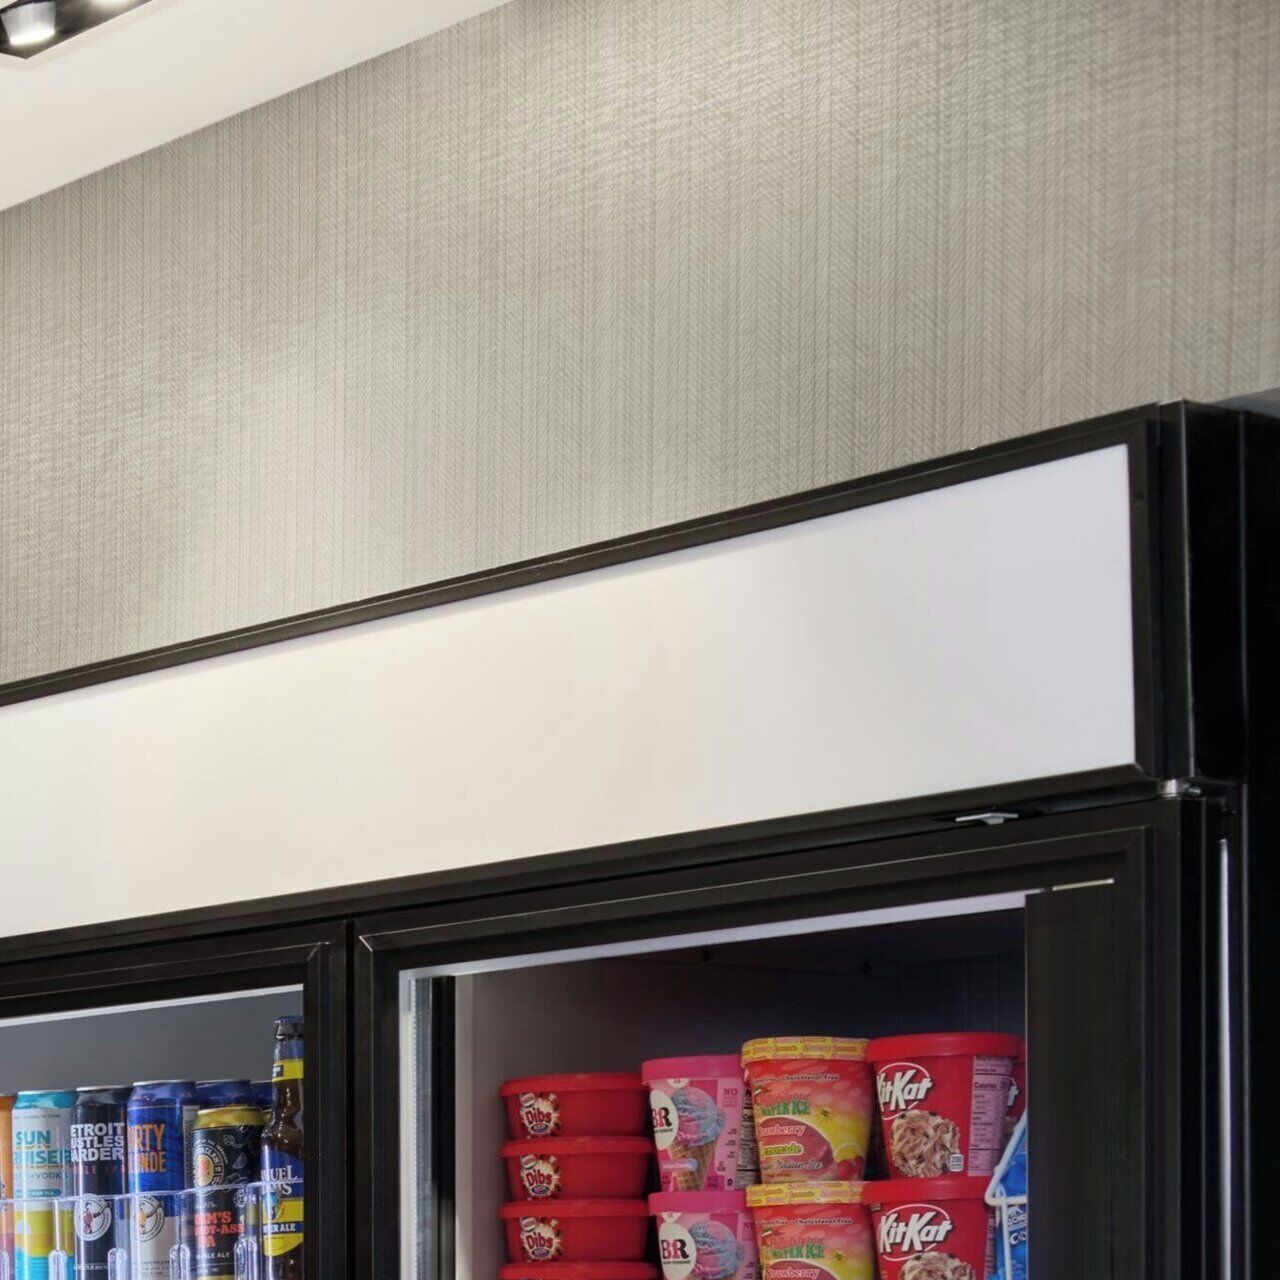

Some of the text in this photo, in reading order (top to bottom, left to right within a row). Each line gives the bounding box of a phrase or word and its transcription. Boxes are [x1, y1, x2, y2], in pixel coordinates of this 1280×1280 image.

[526, 1109, 552, 1124] Dibs
[526, 1172, 552, 1187] Dibs
[526, 1234, 554, 1250] Dibs
